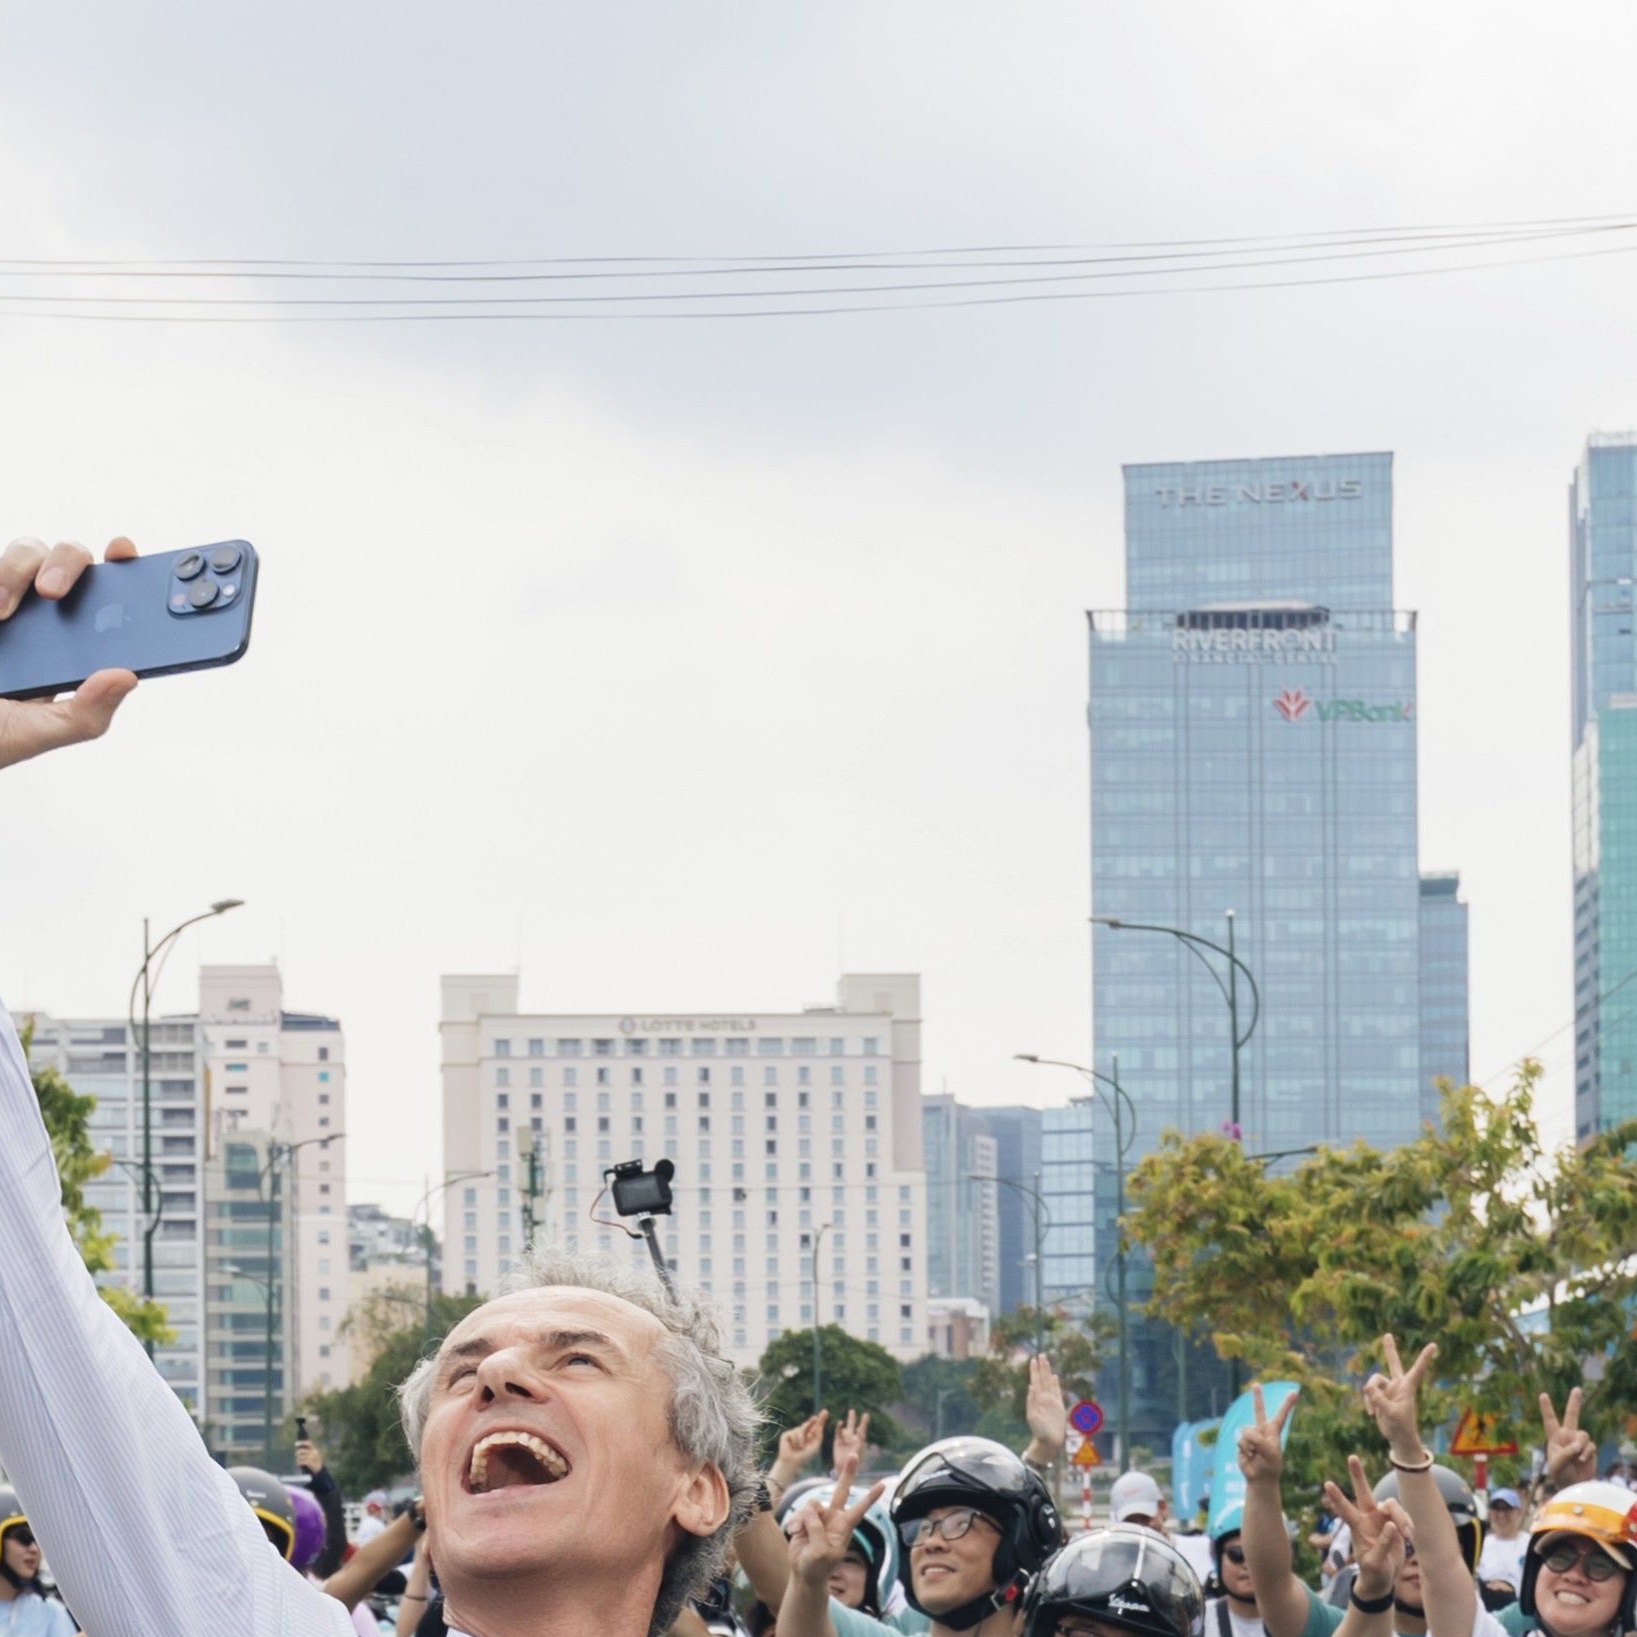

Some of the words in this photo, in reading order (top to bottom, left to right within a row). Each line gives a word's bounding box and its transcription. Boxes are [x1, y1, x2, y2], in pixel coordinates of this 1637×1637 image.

[1155, 486, 1227, 508] THE
[1236, 480, 1362, 504] NEXUS
[1172, 627, 1337, 651] RIVERFRONT
[1316, 699, 1411, 722] VPBank
[641, 1019, 695, 1032] LOTTE
[700, 1019, 756, 1032] HOTELS
